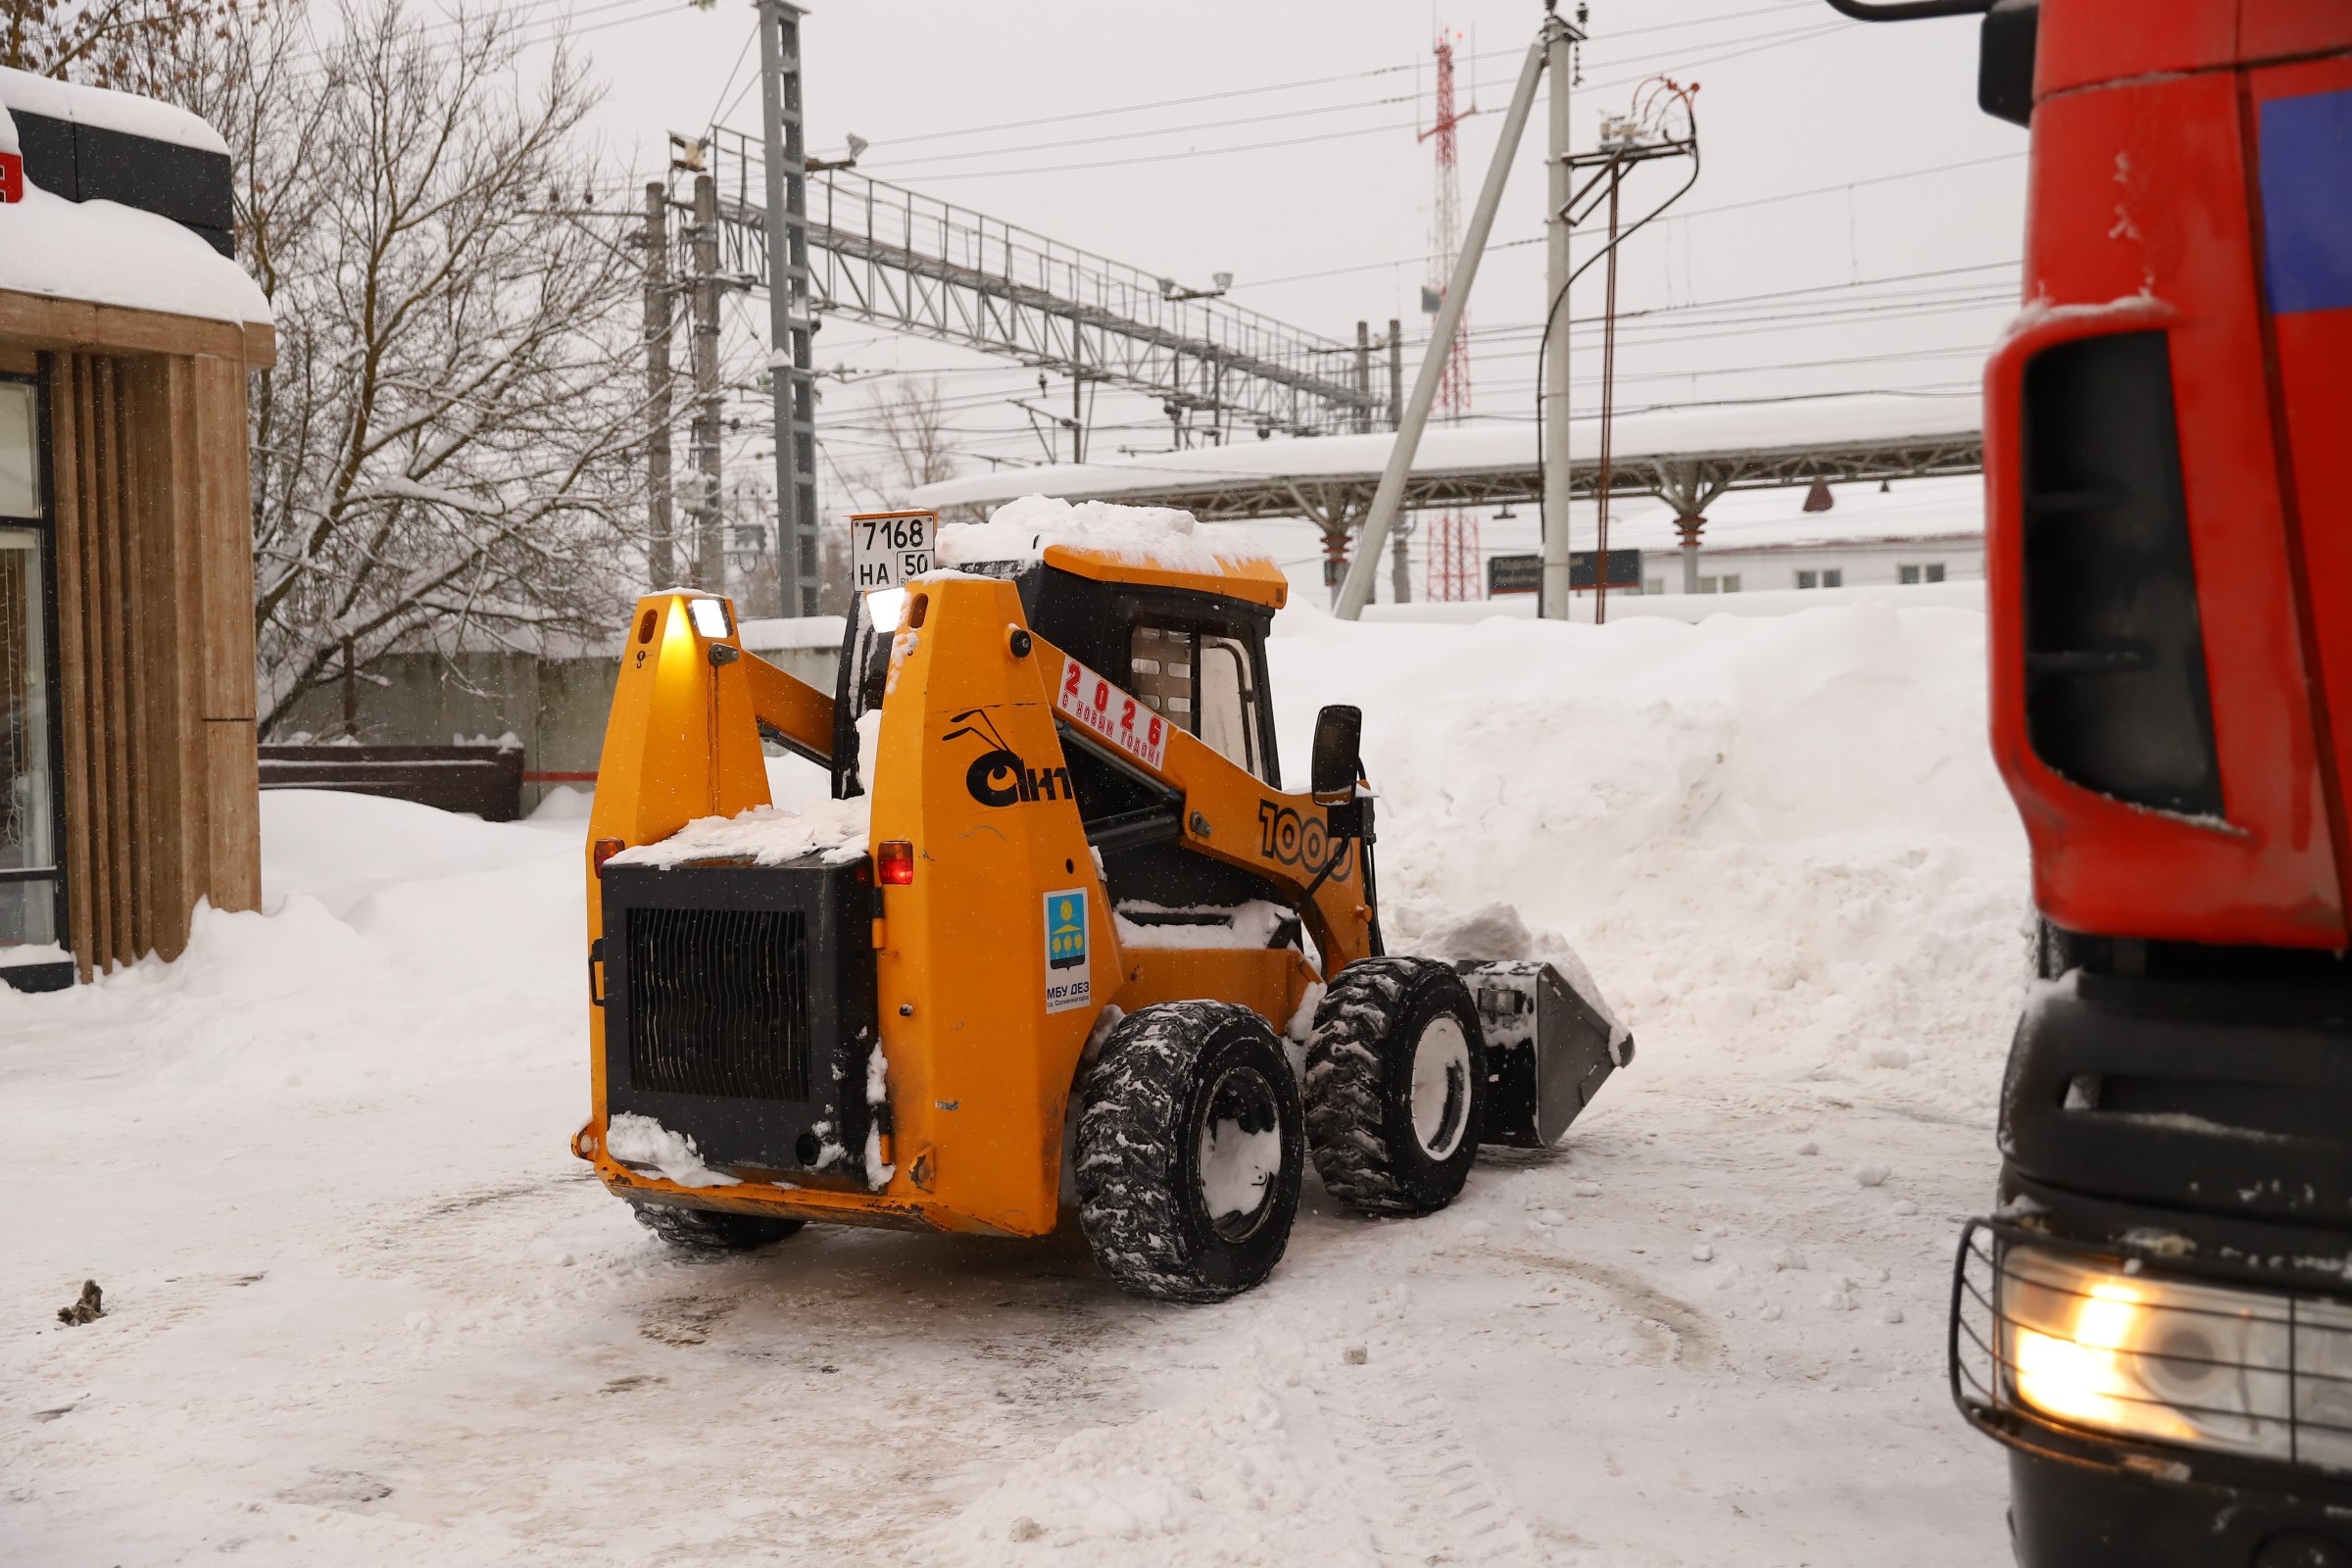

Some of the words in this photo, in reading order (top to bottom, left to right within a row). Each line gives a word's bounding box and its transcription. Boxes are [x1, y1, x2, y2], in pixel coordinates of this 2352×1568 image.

[862, 519, 923, 550] 7168
[859, 563, 890, 585] НА
[905, 554, 928, 576] 50
[1064, 661, 1162, 748] 2026
[1047, 985, 1068, 1000] МБУ
[1070, 981, 1089, 995] ДЕЗ
